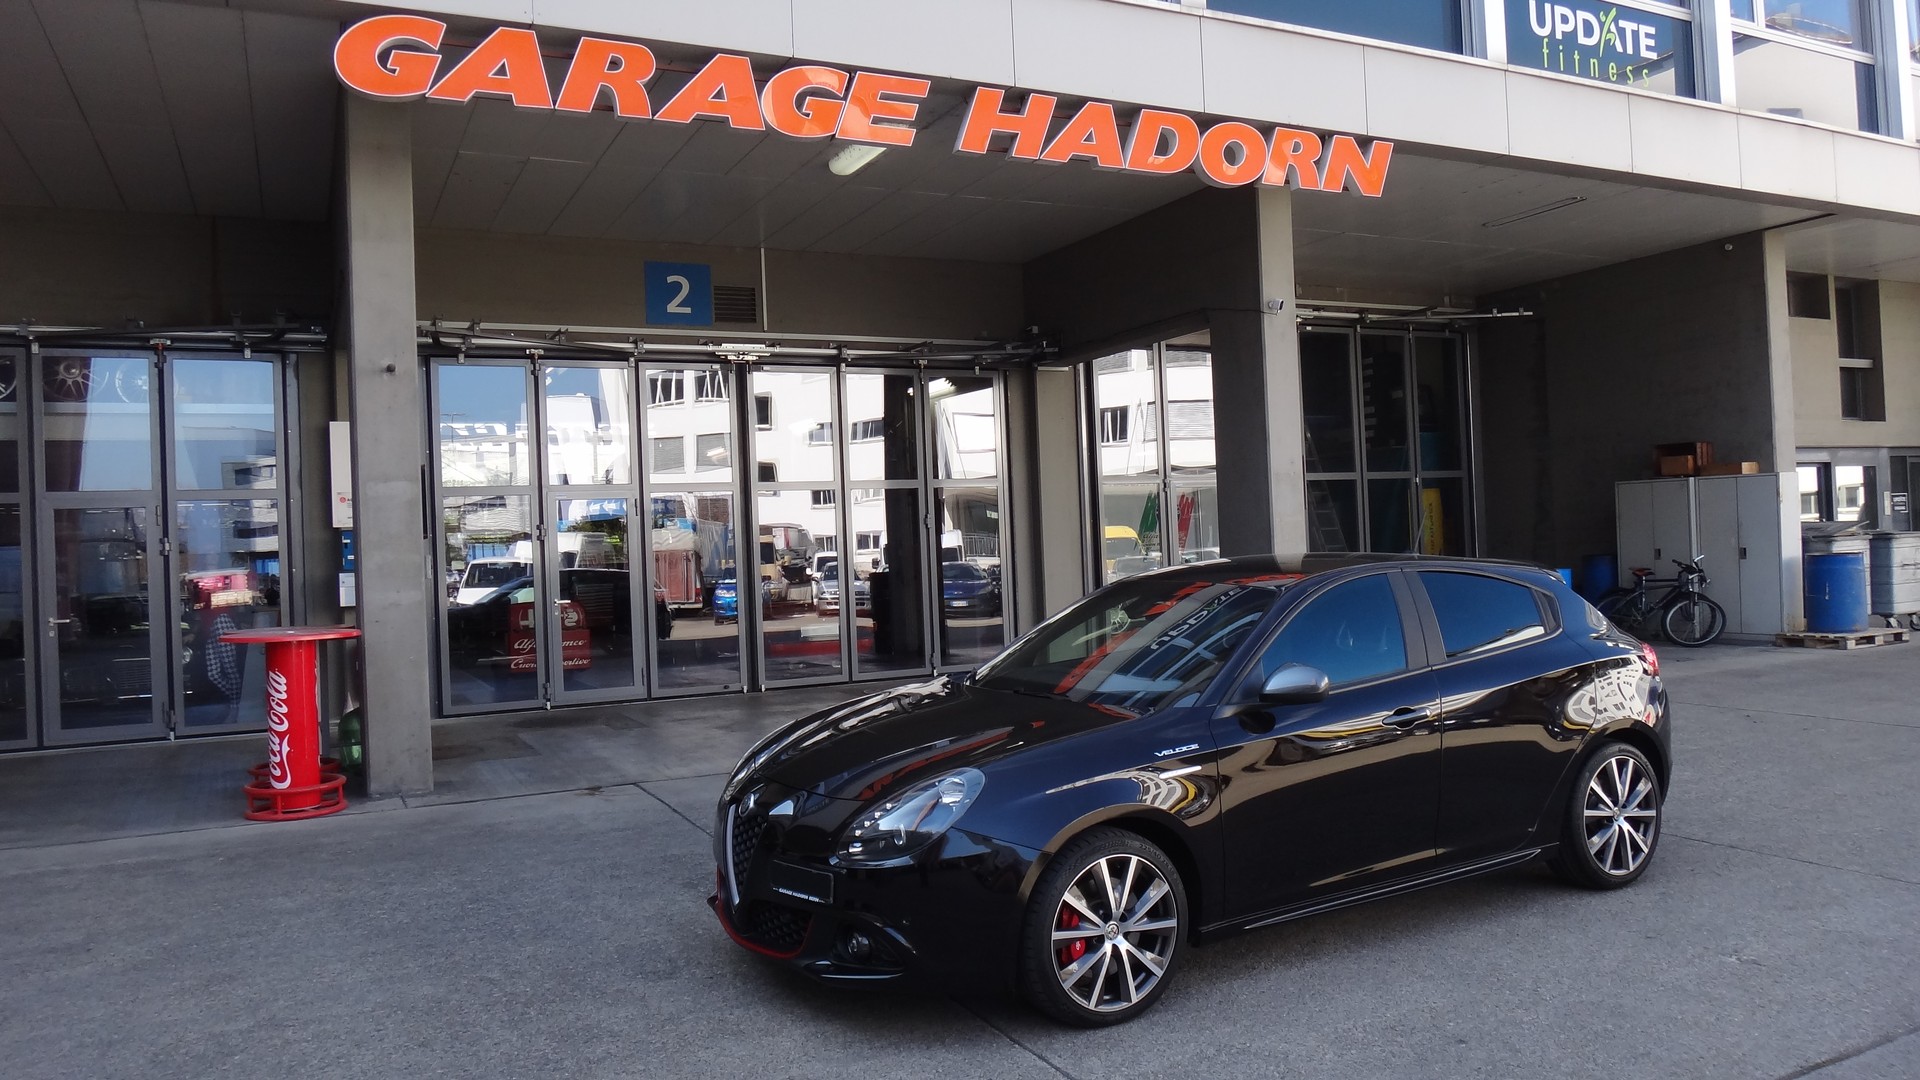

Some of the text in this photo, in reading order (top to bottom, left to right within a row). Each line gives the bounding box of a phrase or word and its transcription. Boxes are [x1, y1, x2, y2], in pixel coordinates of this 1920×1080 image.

[1528, 0, 1658, 59] UPDATE
[1542, 37, 1650, 88] fitness
[334, 14, 1395, 198] GARAGE HADORN
[666, 275, 692, 314] 2
[514, 639, 536, 653] Alf
[1153, 743, 1200, 757] VELOCE
